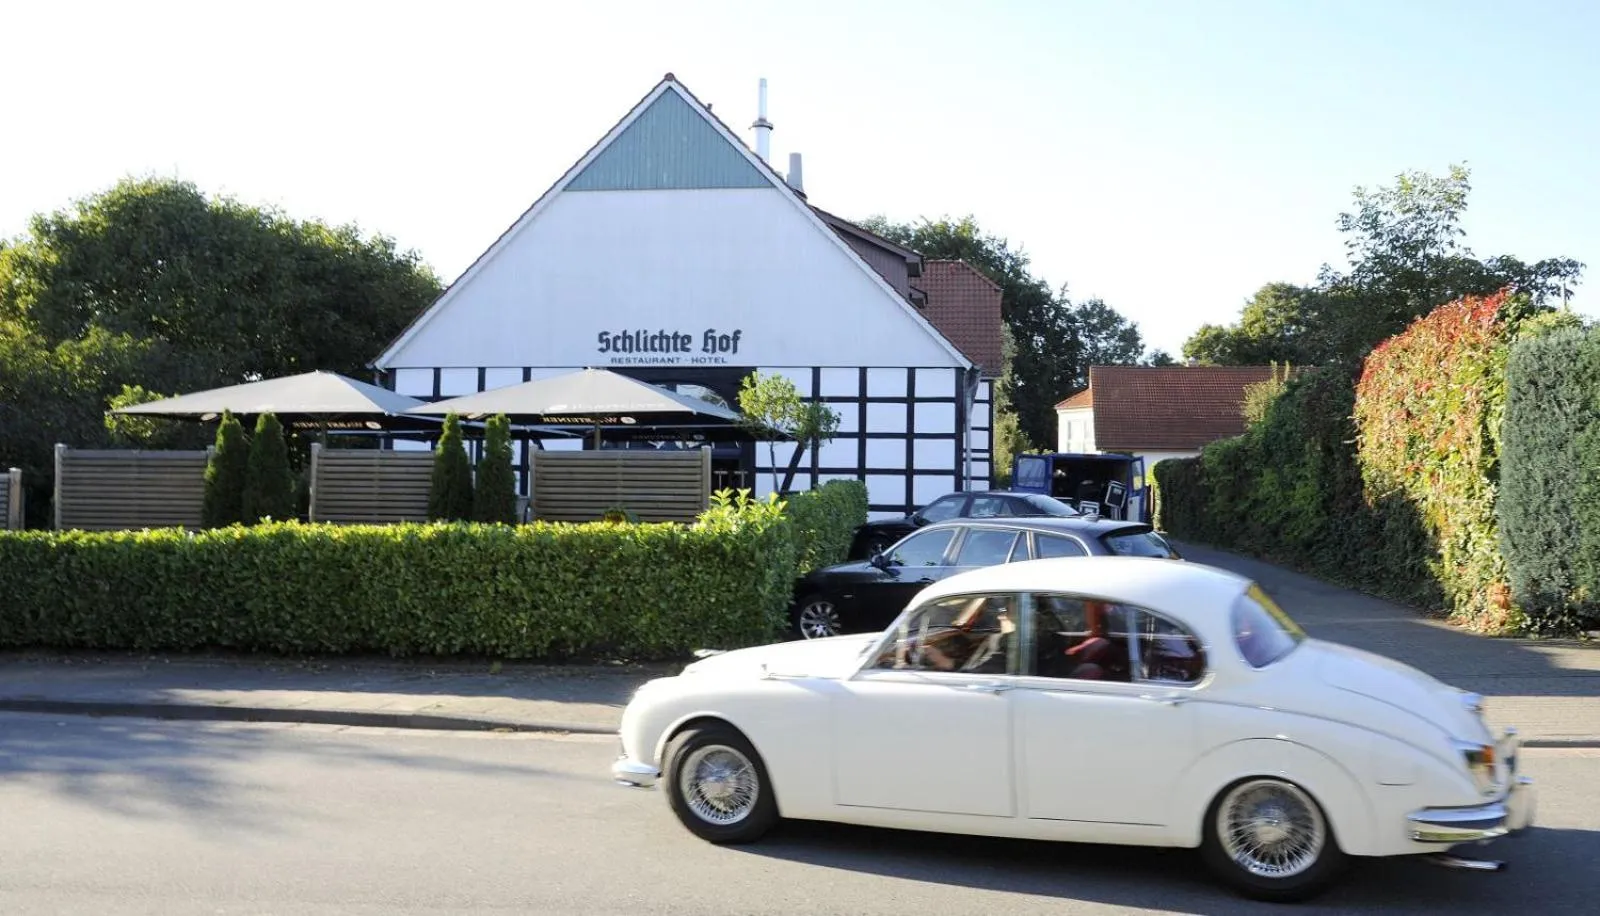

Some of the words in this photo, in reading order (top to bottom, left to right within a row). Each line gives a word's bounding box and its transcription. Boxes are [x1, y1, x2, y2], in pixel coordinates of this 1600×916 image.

[598, 329, 692, 353] Schlichte
[702, 328, 742, 354] Hof
[610, 356, 681, 365] RESTAURANT
[691, 356, 728, 364] HOTEL
